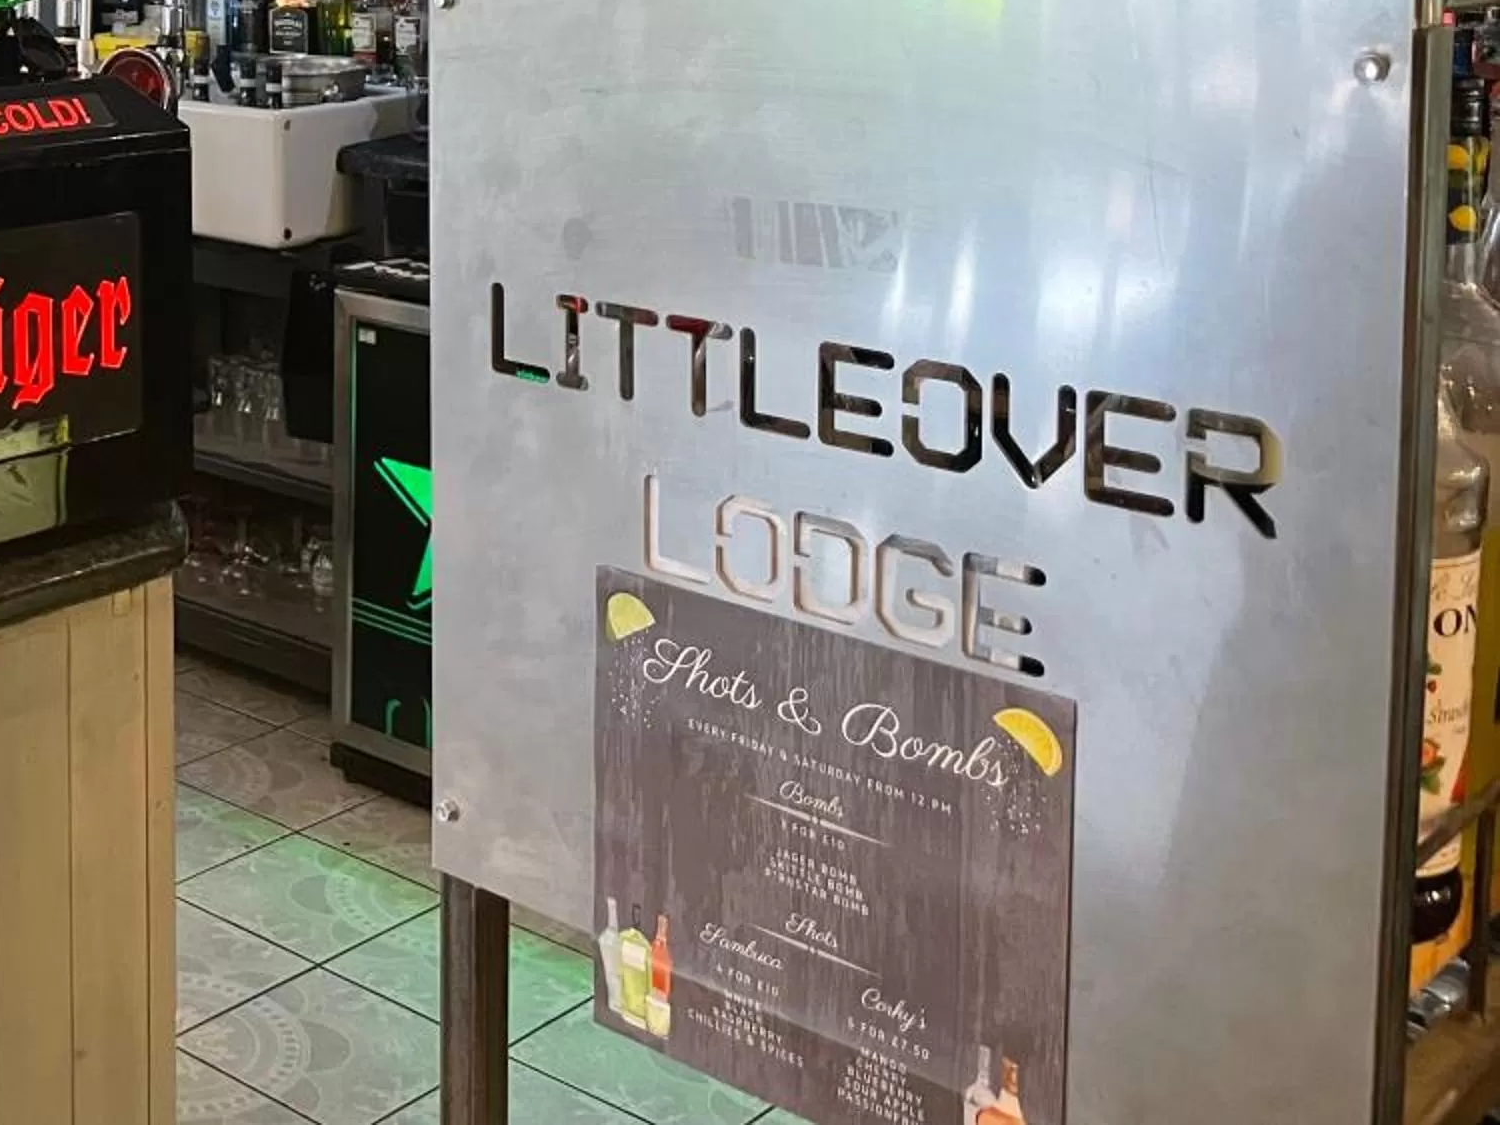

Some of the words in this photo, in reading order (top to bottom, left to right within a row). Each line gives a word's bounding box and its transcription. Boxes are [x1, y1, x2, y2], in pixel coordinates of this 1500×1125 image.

[491, 281, 1285, 539] LITTLEOVER
[642, 475, 1049, 678] LODGE
[643, 638, 763, 709] Shots
[777, 687, 821, 735] &
[842, 703, 1010, 788] Bombs
[688, 719, 725, 743] EVERY
[731, 730, 775, 757] FRIDAY
[793, 754, 862, 789] SATURDAY
[867, 777, 904, 799] FROM
[780, 780, 844, 817] Bombs
[700, 922, 784, 970] Sambuca
[785, 912, 839, 949] Shots
[861, 987, 927, 1032] Corky's
